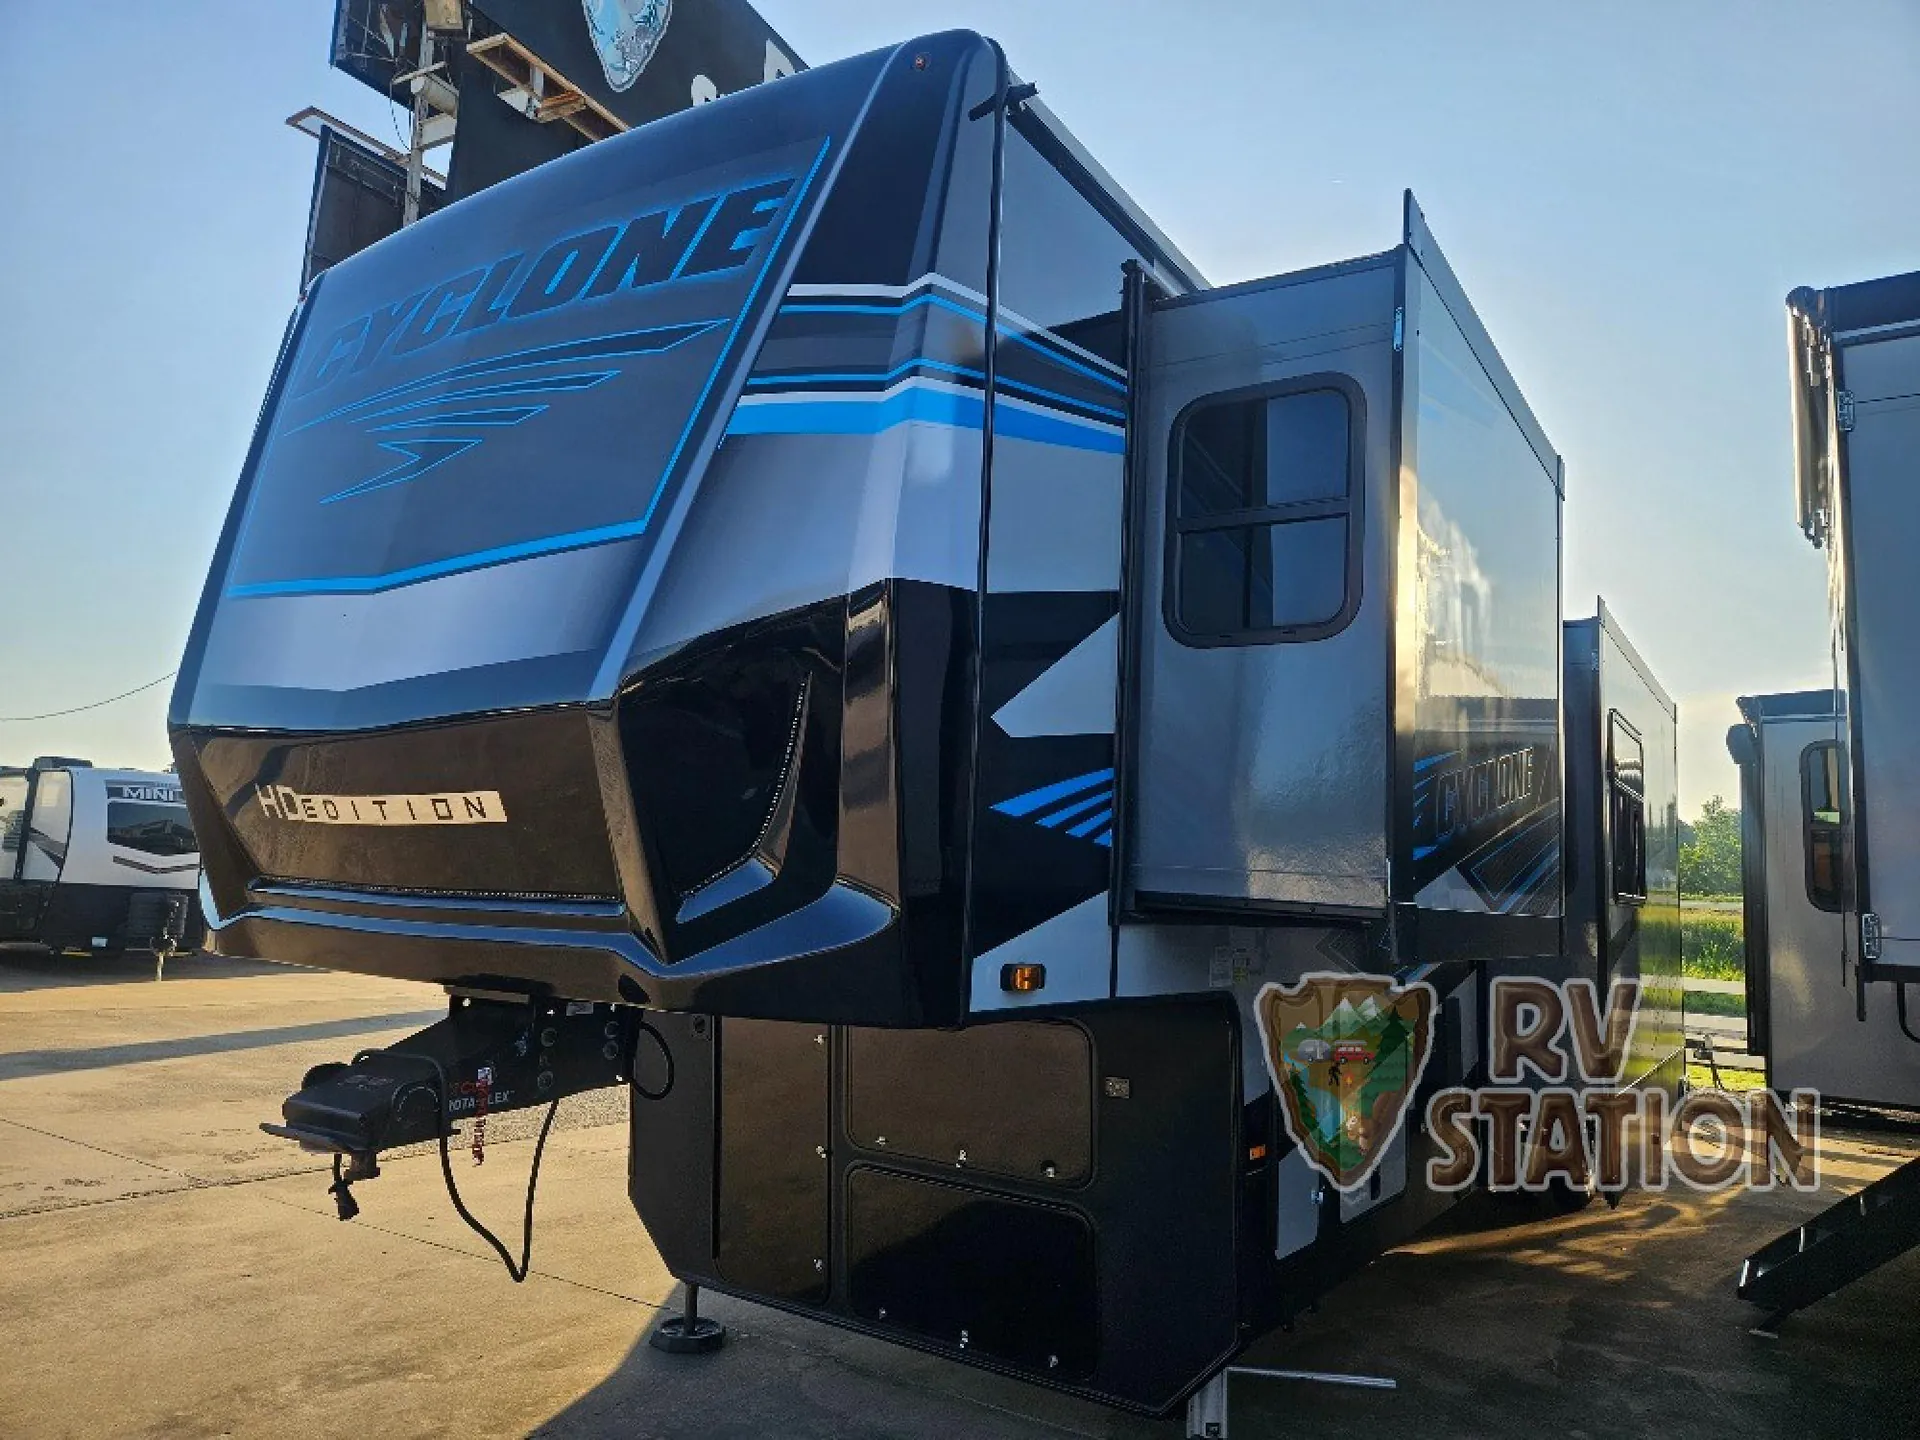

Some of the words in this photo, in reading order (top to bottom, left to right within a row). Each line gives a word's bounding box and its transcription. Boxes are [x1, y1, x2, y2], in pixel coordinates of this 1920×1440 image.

[294, 174, 799, 399] CYCLONE
[122, 785, 174, 801] MINI
[300, 794, 489, 821] EDITION
[1436, 746, 1534, 838] CYCLONE
